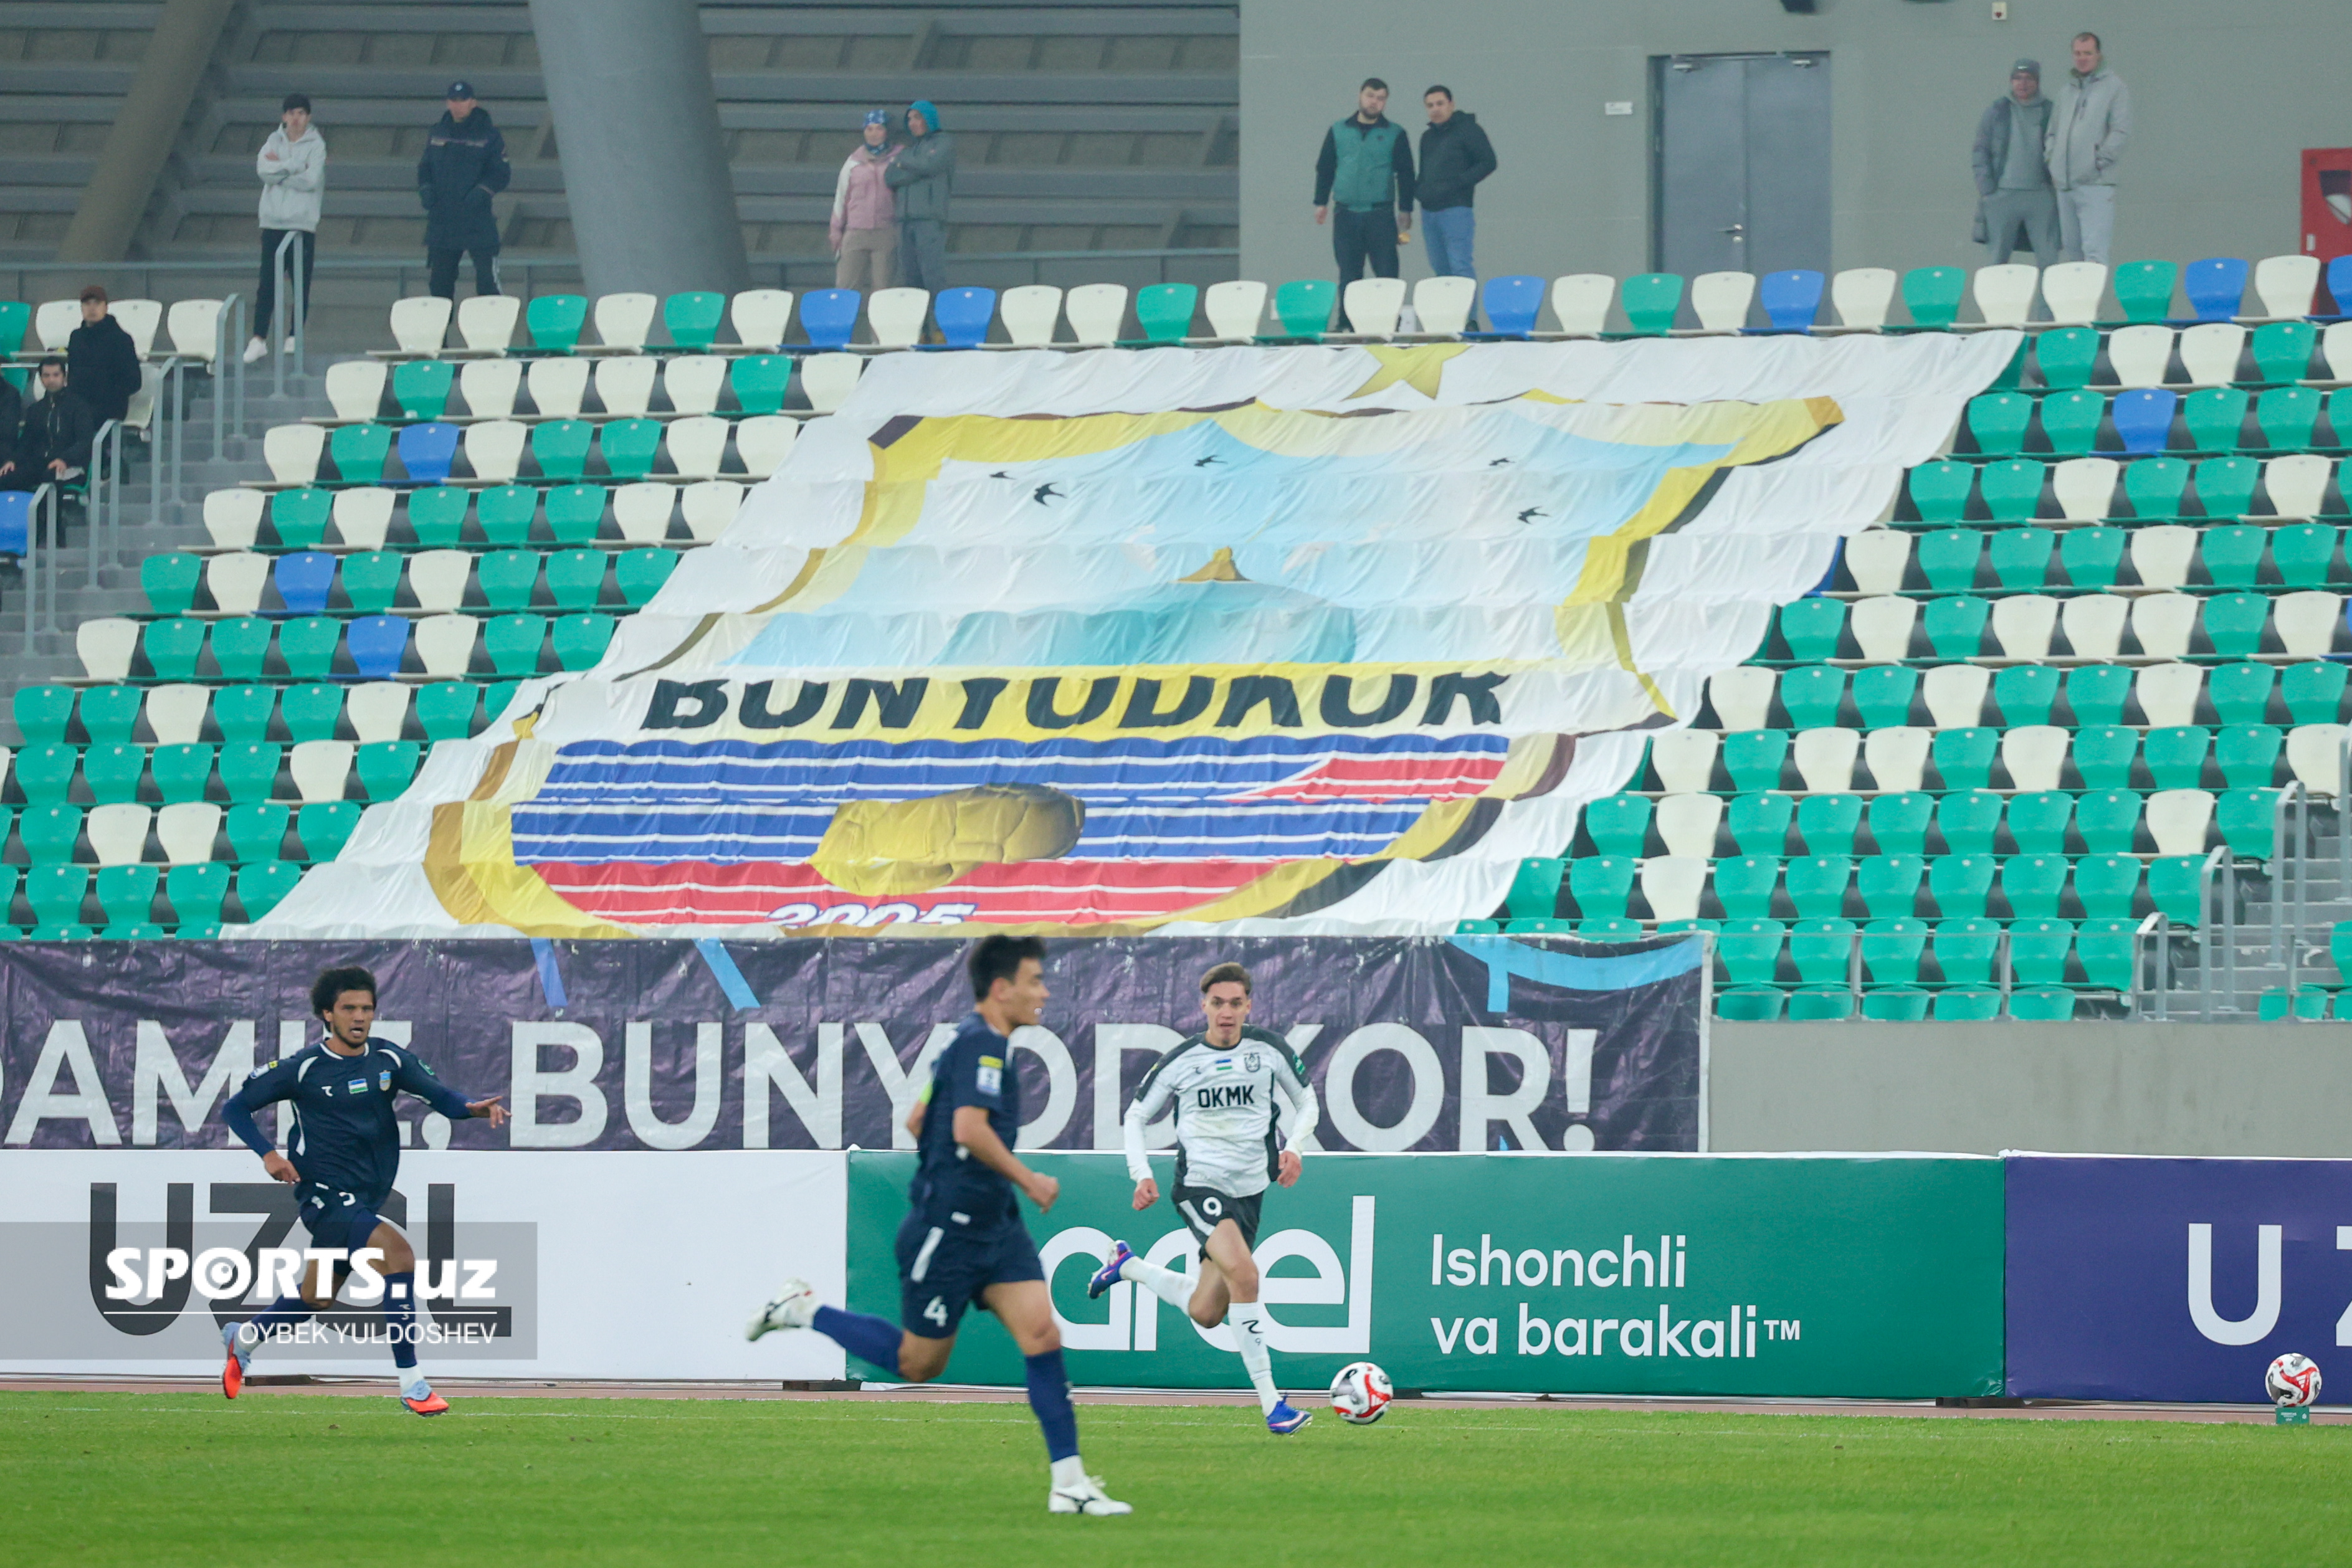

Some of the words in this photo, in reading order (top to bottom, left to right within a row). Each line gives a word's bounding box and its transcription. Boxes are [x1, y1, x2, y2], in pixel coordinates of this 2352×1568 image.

[1197, 1085, 1255, 1108] OKMK
[1202, 1196, 1223, 1217] 9
[1431, 1233, 1687, 1288] Ishonchli
[923, 1295, 948, 1328] 4
[1430, 1318, 1497, 1355] va
